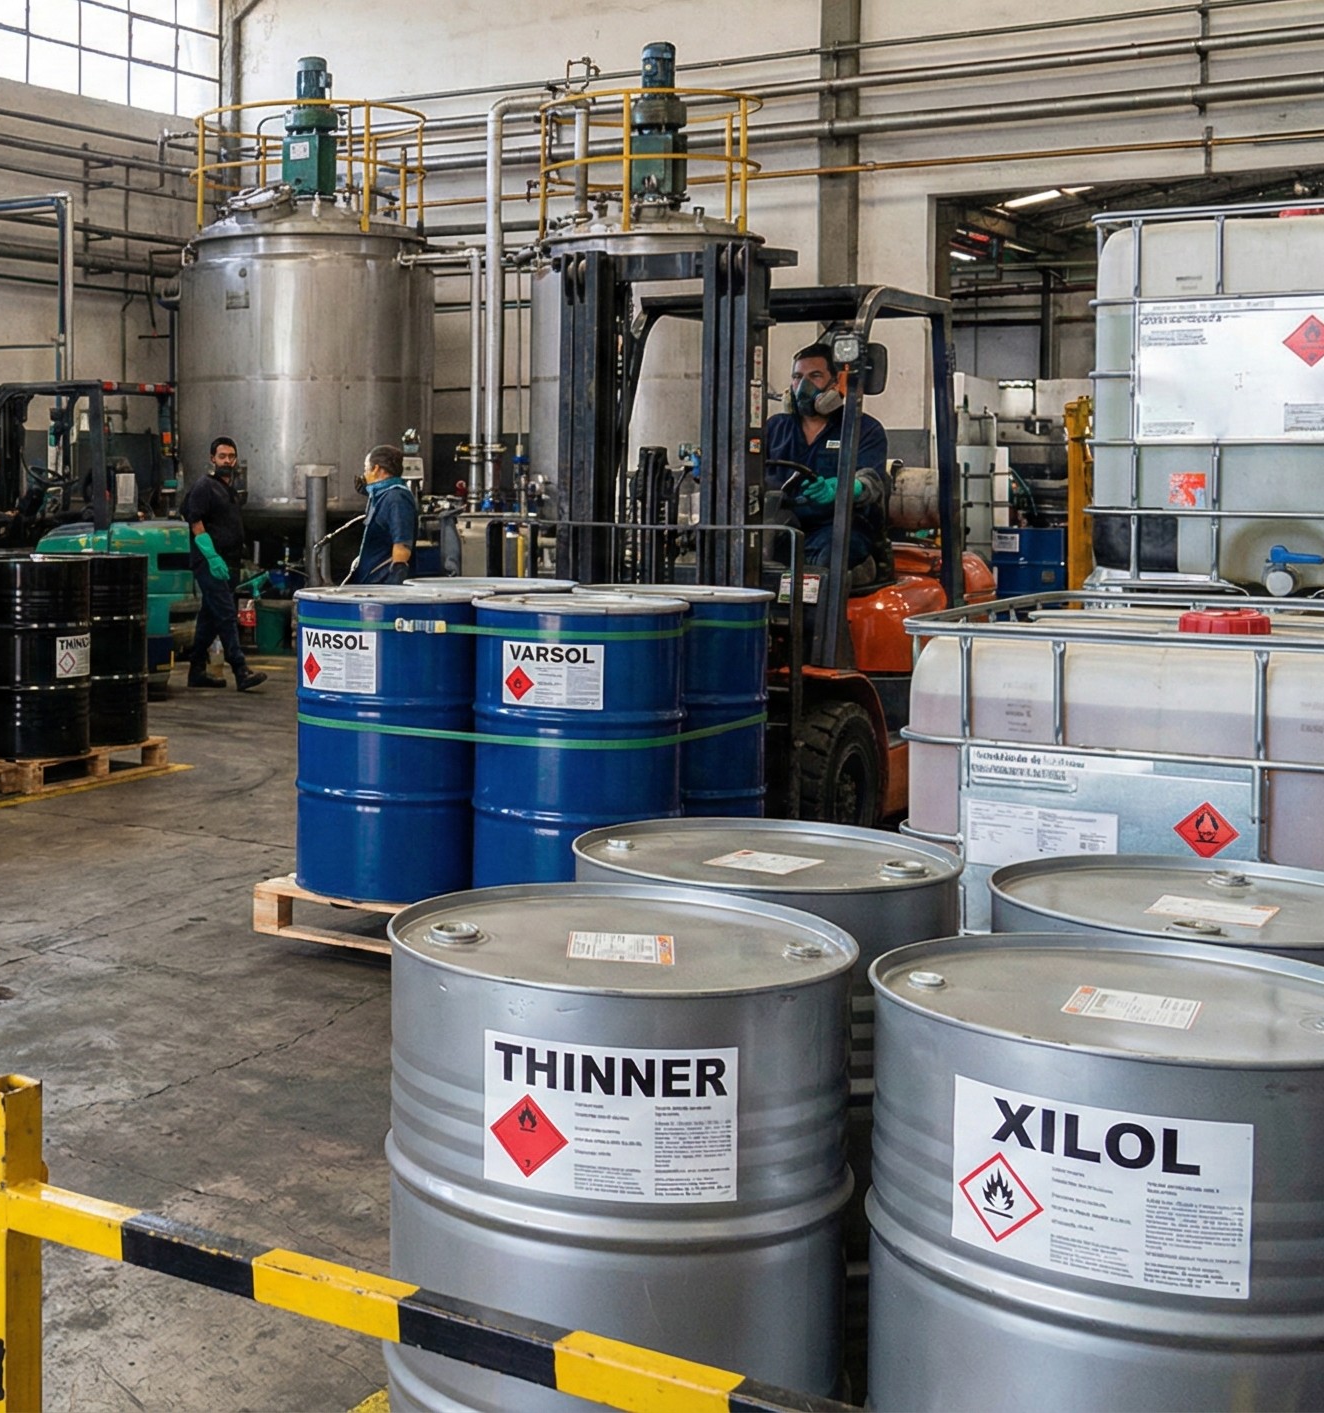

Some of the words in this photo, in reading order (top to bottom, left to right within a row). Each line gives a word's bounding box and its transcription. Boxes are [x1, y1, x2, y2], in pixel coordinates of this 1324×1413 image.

[306, 630, 369, 651] VARSOL
[509, 644, 596, 664] VARSOL
[494, 1040, 728, 1098] THINNER
[991, 1096, 1201, 1176] XILOL
